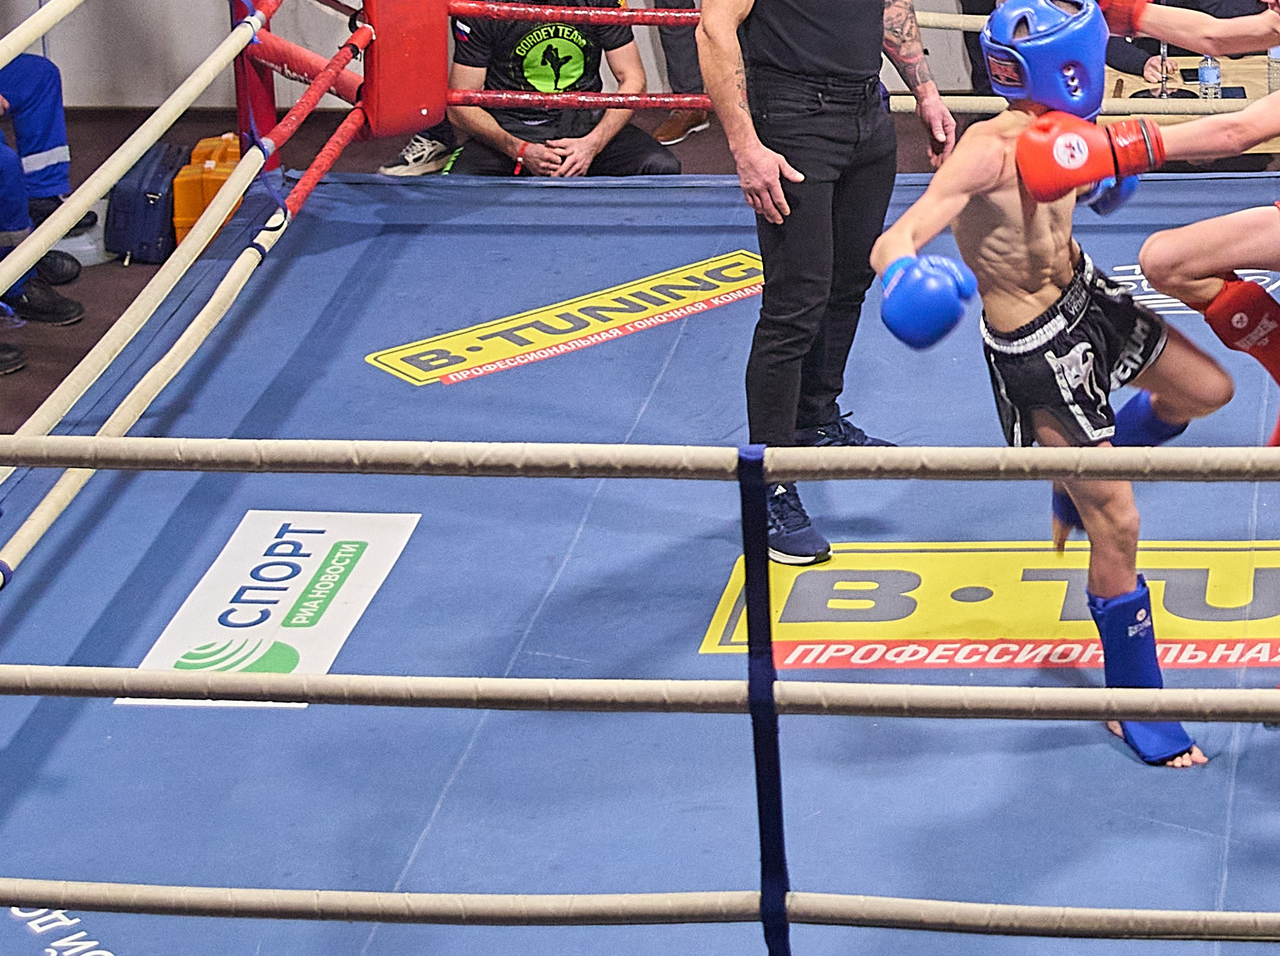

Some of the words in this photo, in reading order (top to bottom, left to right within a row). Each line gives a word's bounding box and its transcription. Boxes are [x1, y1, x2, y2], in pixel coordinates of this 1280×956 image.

[515, 25, 556, 57] GORDEY
[556, 25, 587, 48] TEAM
[448, 327, 623, 382] ПРОФЕССИОНАЛЬНАЯ
[625, 300, 708, 333] ГОНОЧНАЯ
[710, 282, 763, 307] КОМАН
[217, 522, 327, 629] СПОРТ
[290, 599, 324, 624] РИА
[311, 543, 360, 599] НОВОСТИ
